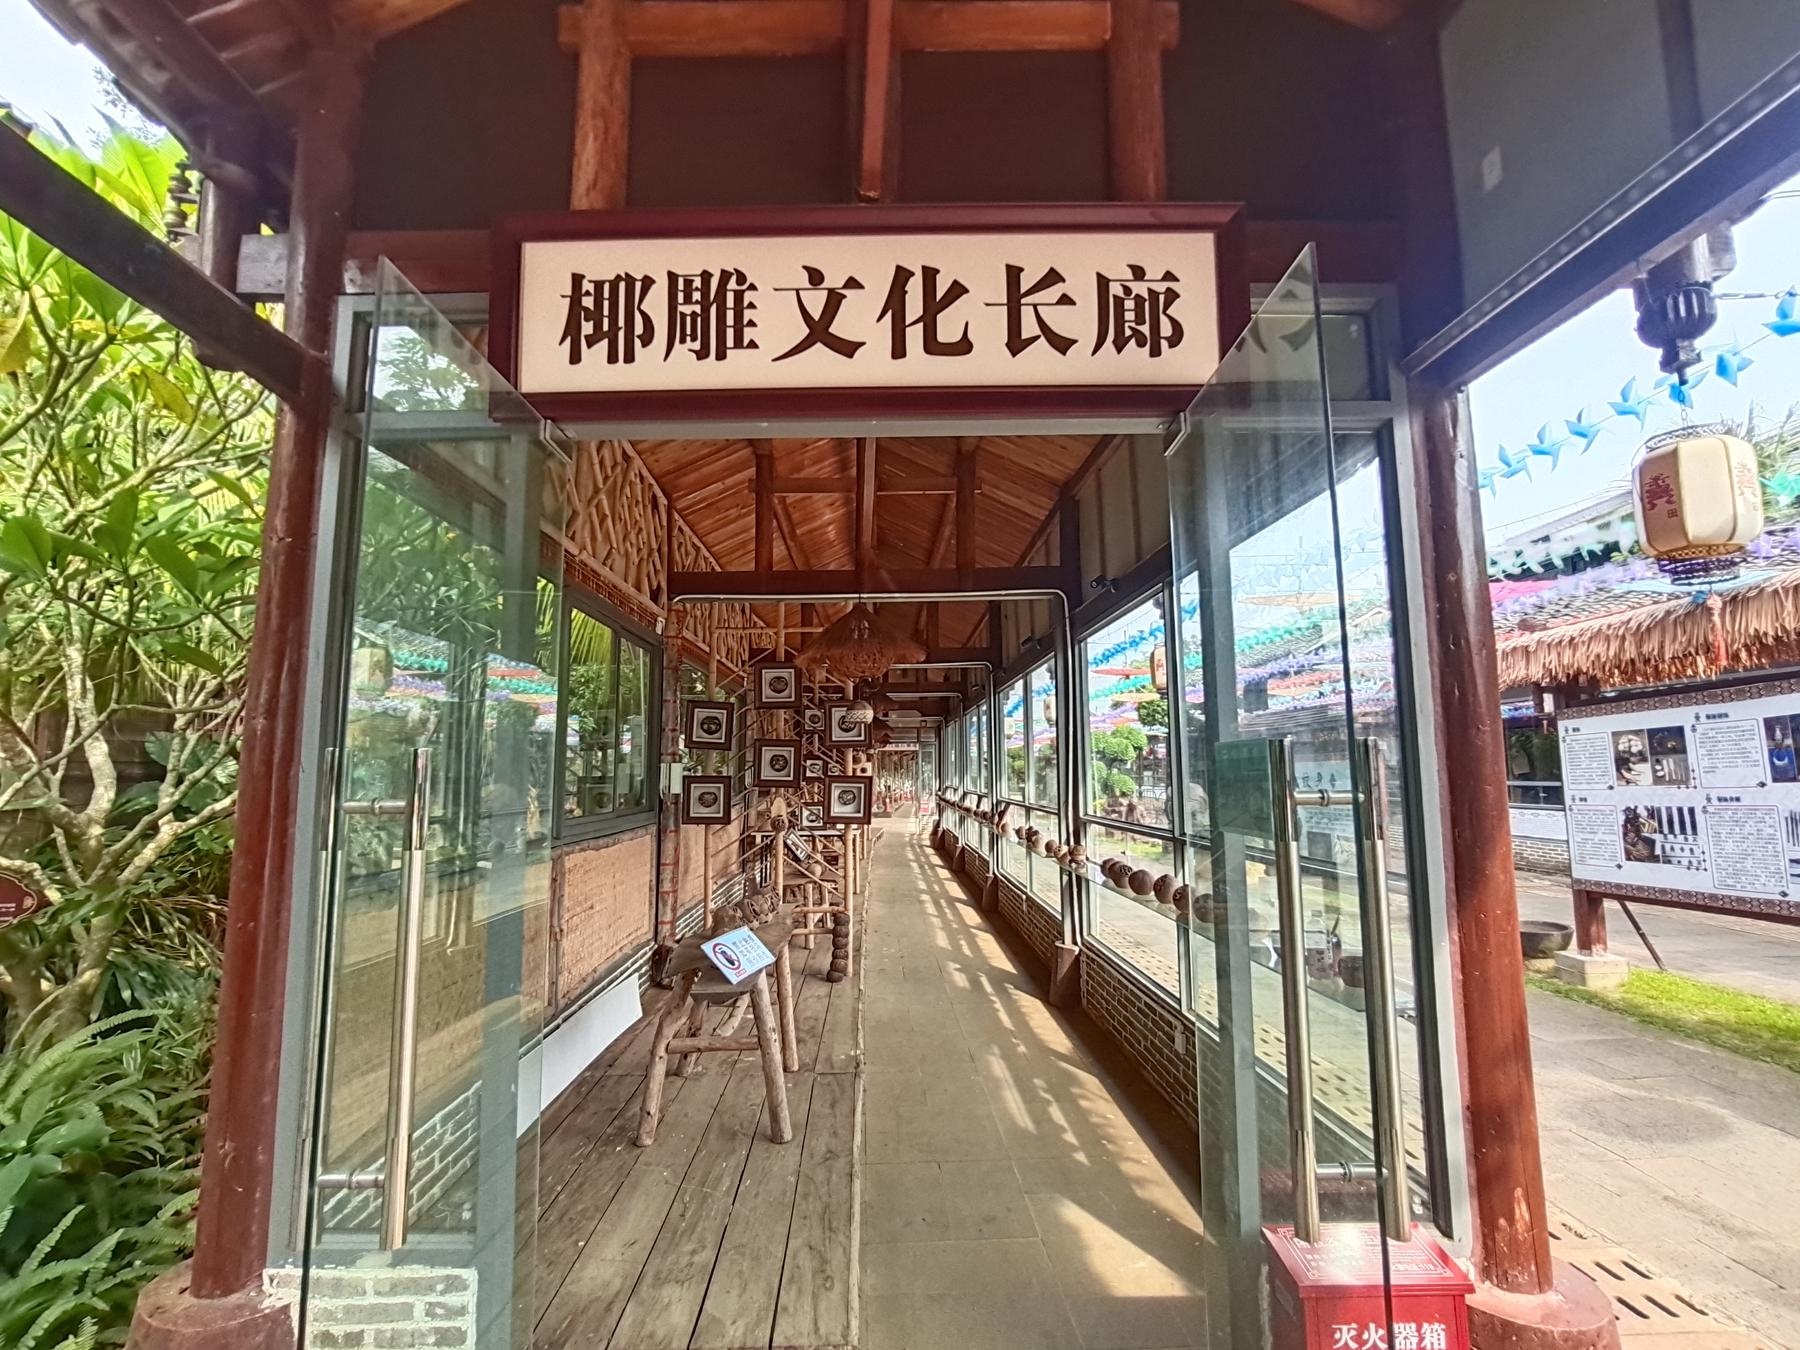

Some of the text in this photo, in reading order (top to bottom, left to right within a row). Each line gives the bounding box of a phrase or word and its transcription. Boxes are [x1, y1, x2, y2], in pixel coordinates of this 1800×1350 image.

[559, 263, 1185, 366] 椰雕文化长廊
[1331, 1321, 1447, 1350] 灭火器箱
